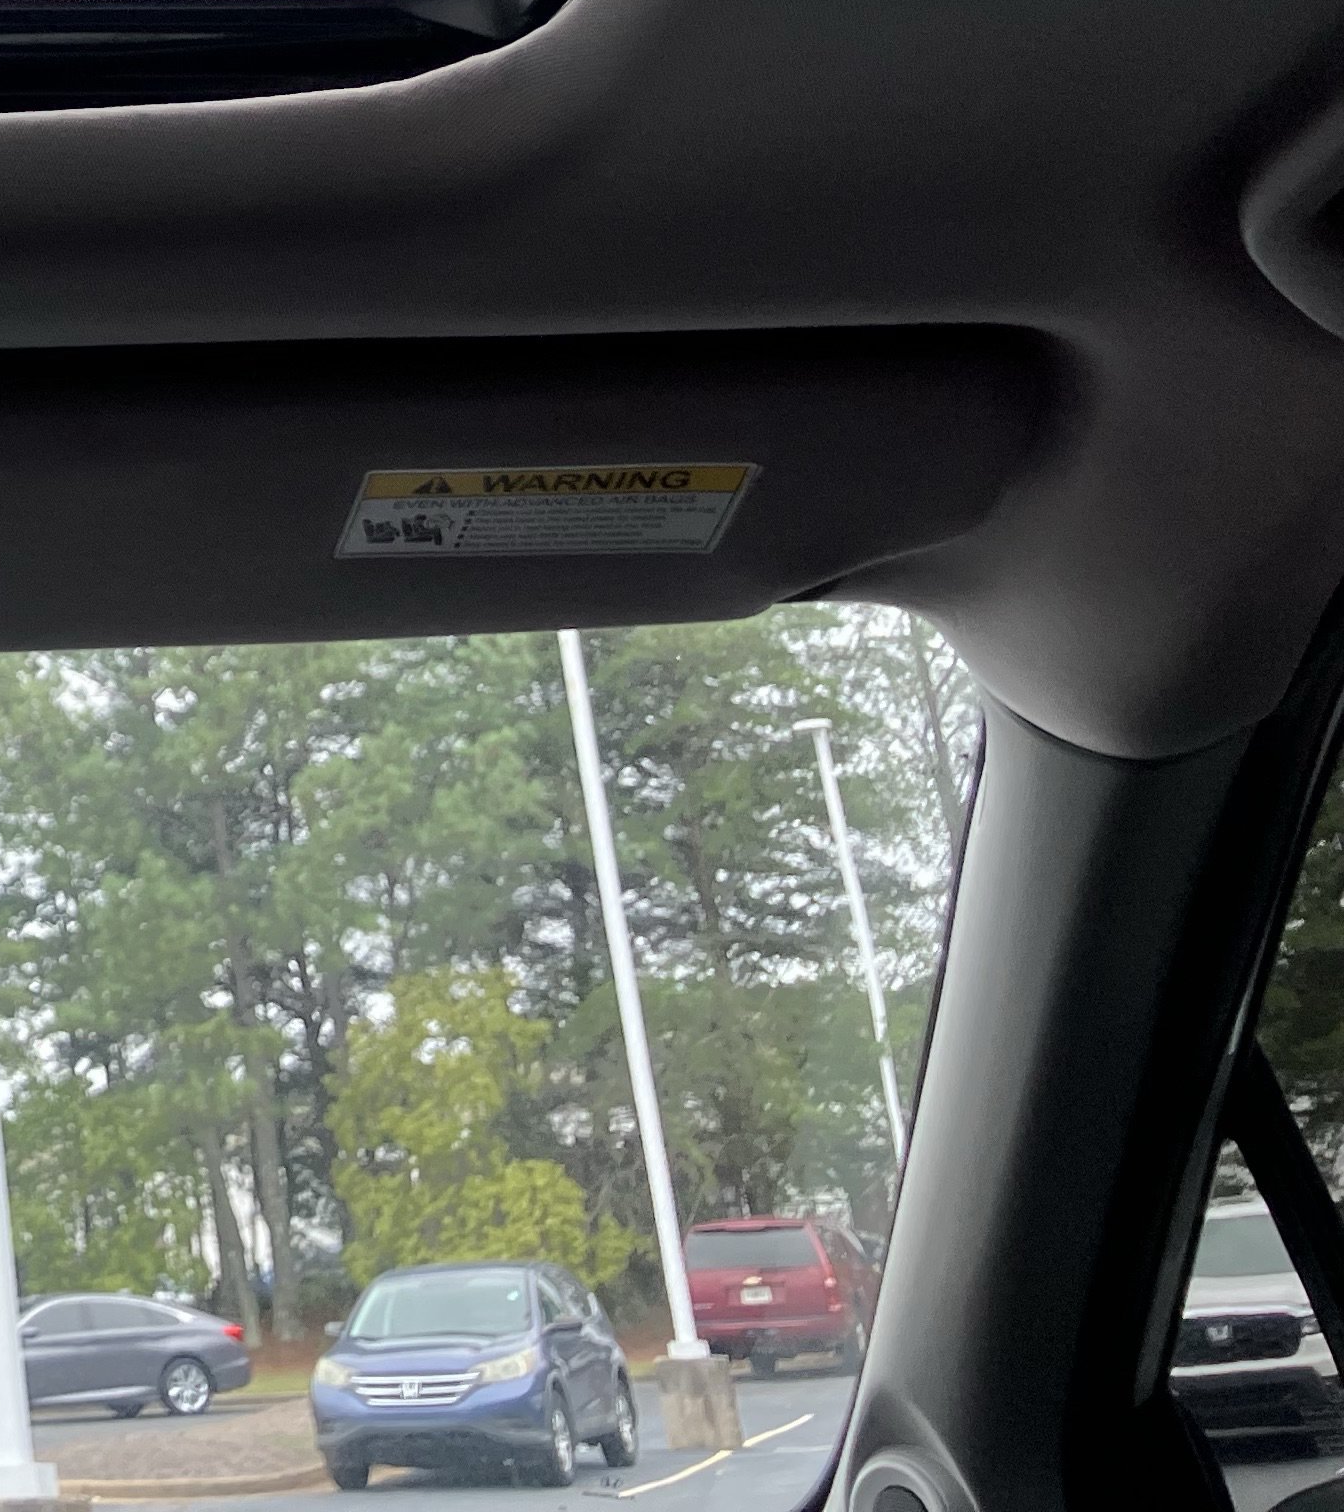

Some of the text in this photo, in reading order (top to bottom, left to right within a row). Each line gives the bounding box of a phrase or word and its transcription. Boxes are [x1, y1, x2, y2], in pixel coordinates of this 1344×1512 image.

[482, 470, 692, 493] WARNING
[393, 498, 444, 509] EVEN
[449, 498, 499, 508] WITH
[502, 496, 604, 507] ADVANCED
